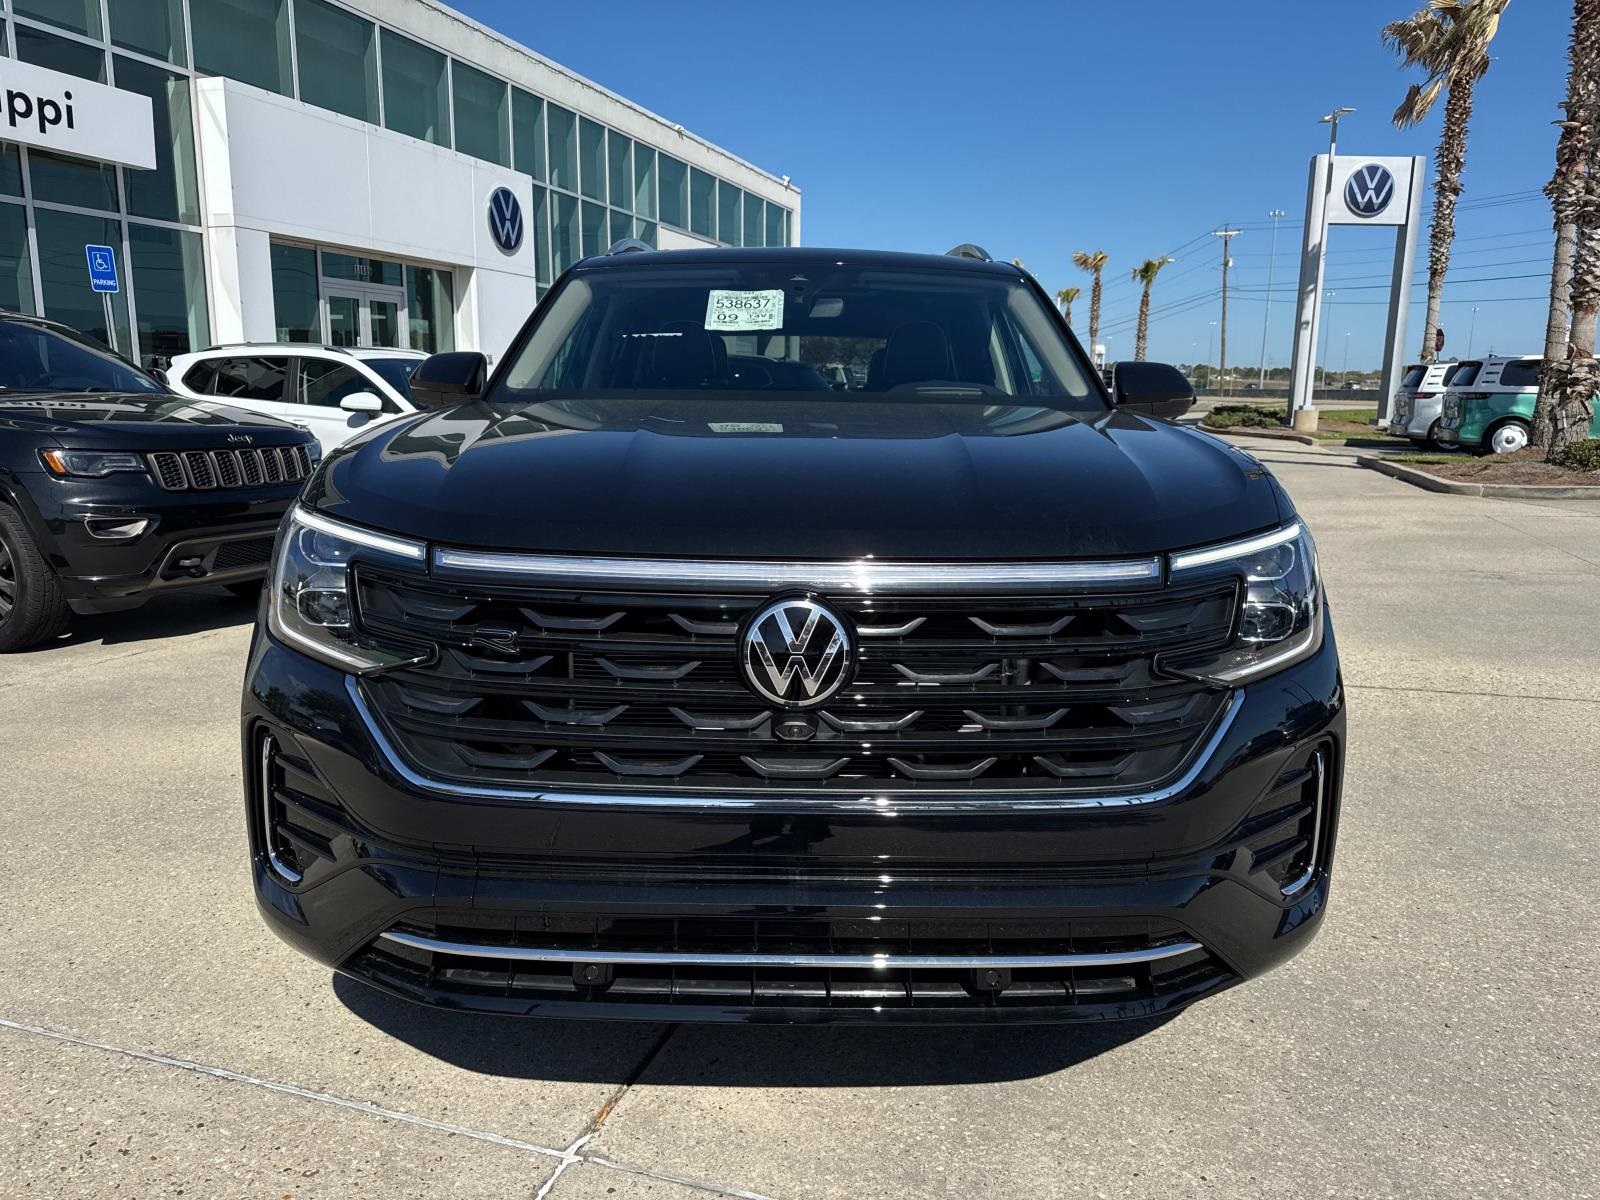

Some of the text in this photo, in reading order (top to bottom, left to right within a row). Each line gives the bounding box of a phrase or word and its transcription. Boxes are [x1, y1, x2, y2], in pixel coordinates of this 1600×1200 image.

[0, 89, 75, 134] ppi
[93, 279, 117, 287] PARKING
[716, 298, 771, 309] 538637
[228, 433, 253, 444] Jeep
